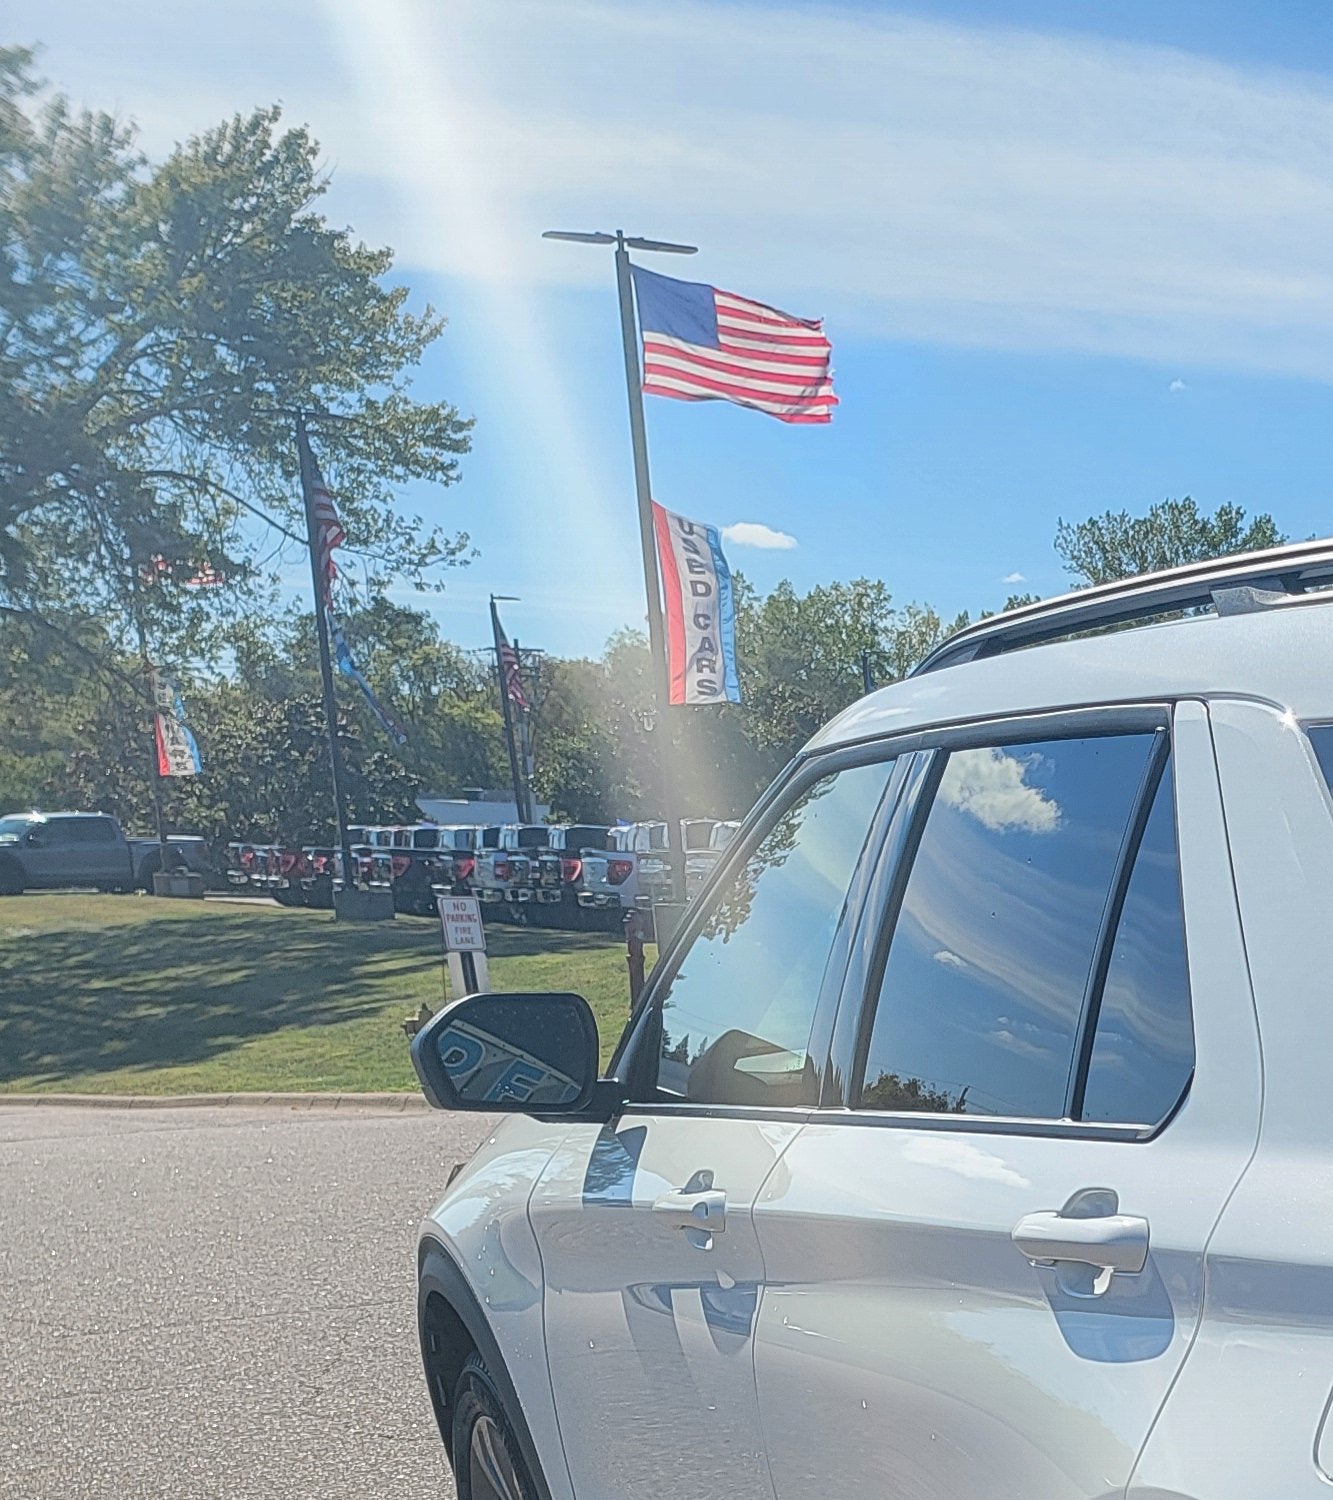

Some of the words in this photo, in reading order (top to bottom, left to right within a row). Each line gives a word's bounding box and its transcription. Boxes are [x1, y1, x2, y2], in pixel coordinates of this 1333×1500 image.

[675, 516, 712, 597] USED
[693, 613, 718, 697] CARS
[453, 902, 467, 912] NO
[446, 913, 478, 923] PARKING
[455, 926, 472, 935] FIRE
[455, 936, 476, 945] LANE
